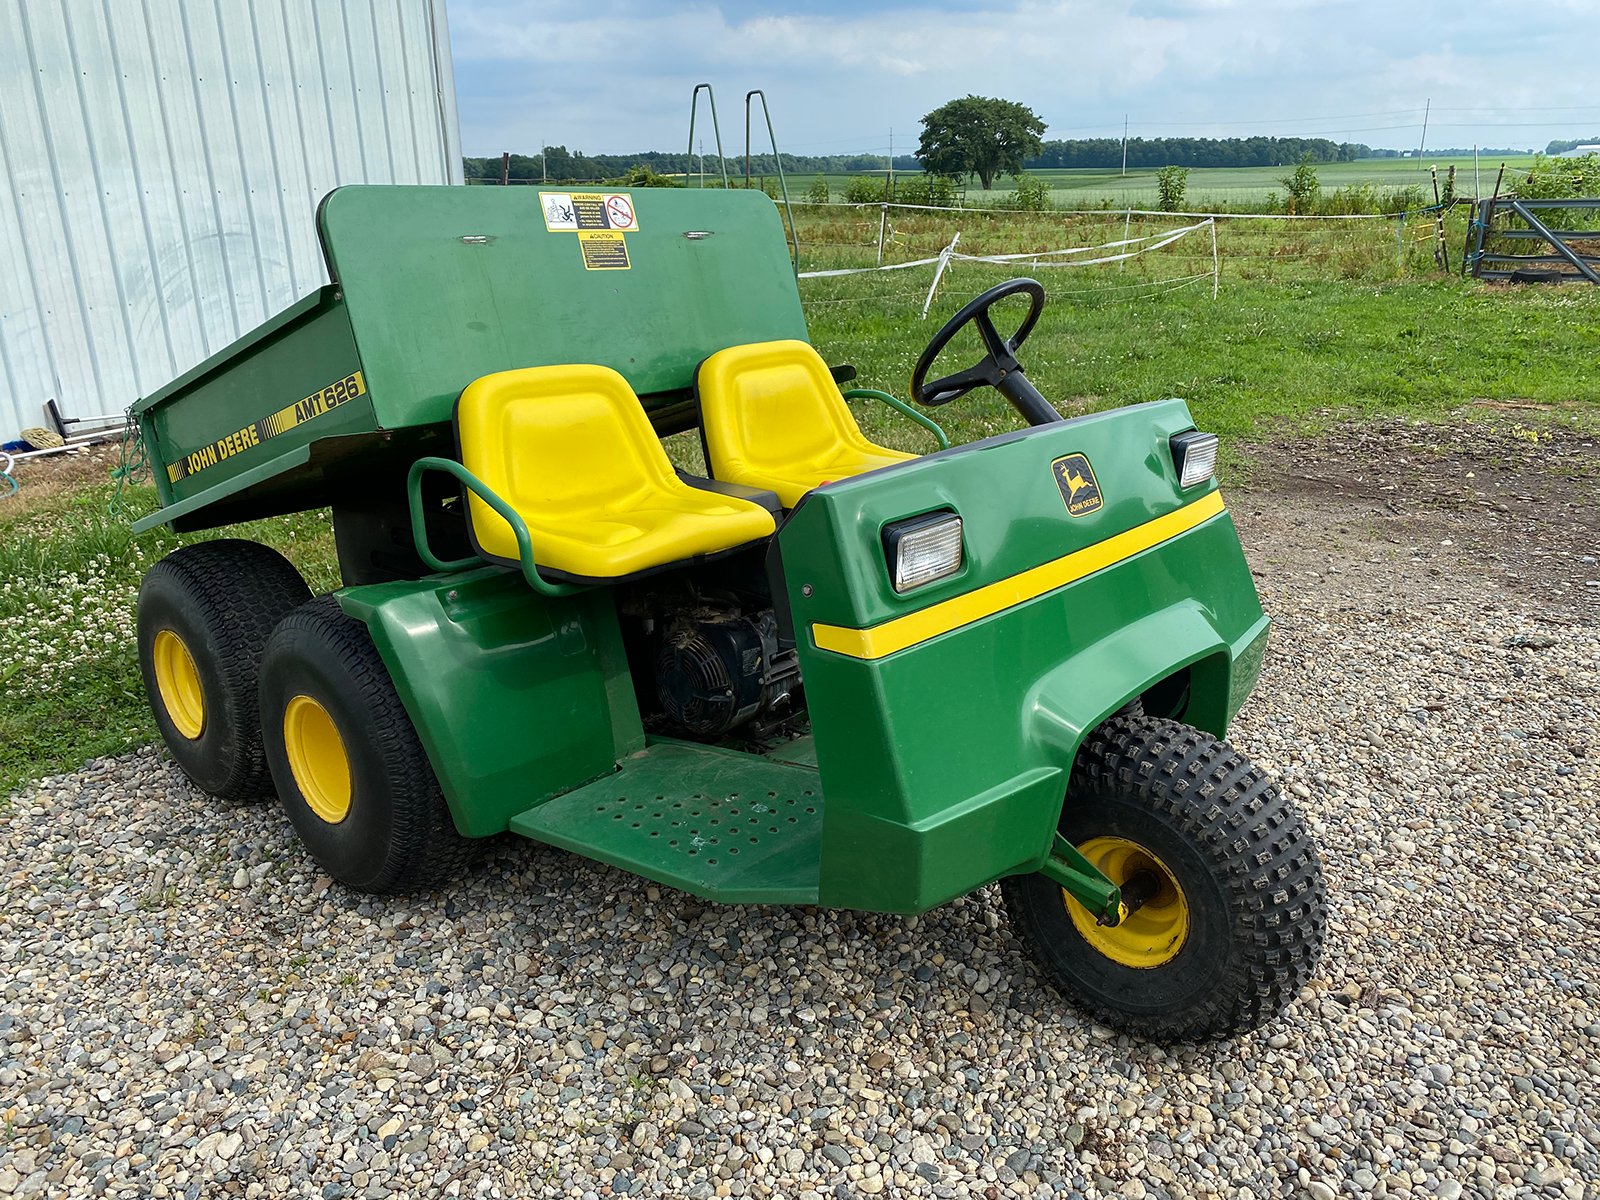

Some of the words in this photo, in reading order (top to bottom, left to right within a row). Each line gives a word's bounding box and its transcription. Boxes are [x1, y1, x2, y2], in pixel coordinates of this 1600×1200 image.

[187, 444, 218, 475] JOHN
[217, 424, 260, 460] DEERE
[294, 393, 322, 424] AMT
[323, 375, 359, 409] 626
[1070, 502, 1084, 512] JOHN
[1083, 497, 1099, 508] DEERE
